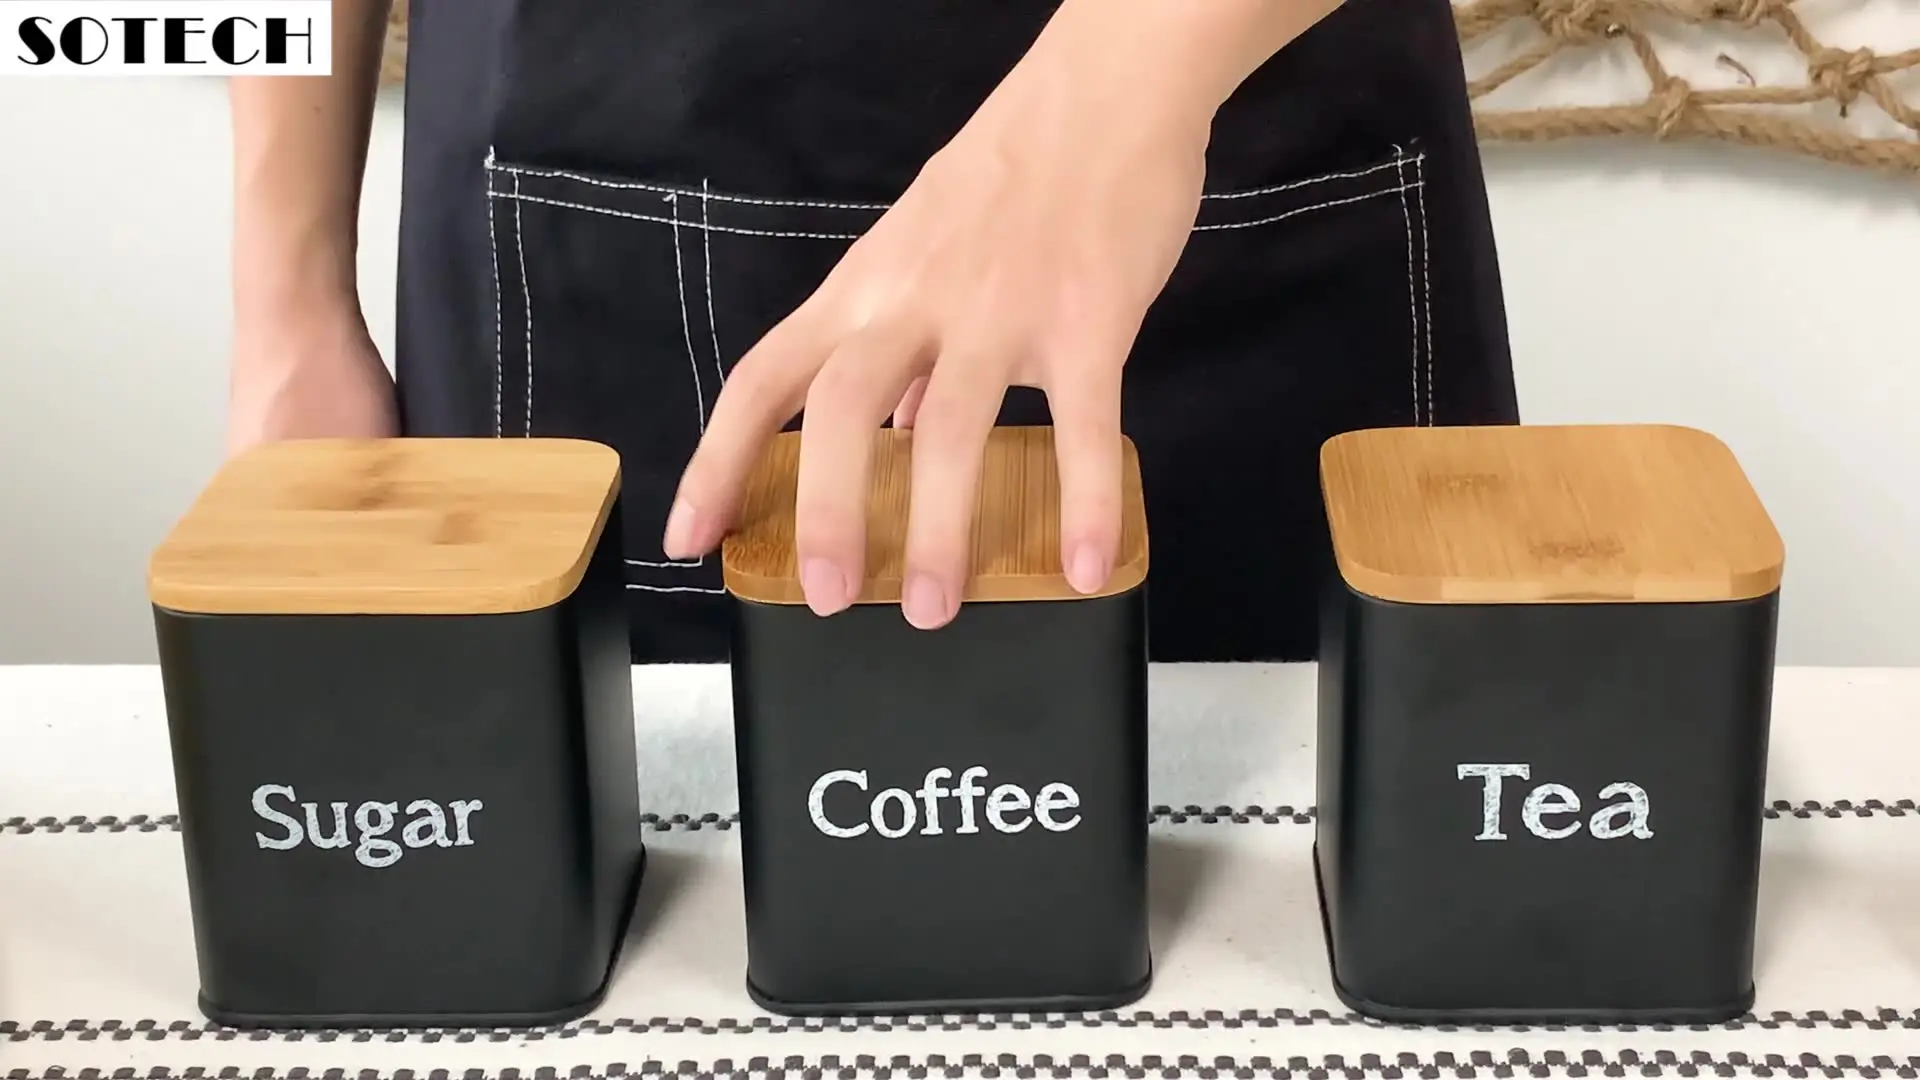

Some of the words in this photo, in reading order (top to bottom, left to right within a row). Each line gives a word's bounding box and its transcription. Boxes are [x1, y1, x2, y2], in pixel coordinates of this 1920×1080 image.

[251, 783, 483, 868] Sugar
[807, 765, 1081, 839] Coffee
[1456, 763, 1654, 841] Tea
